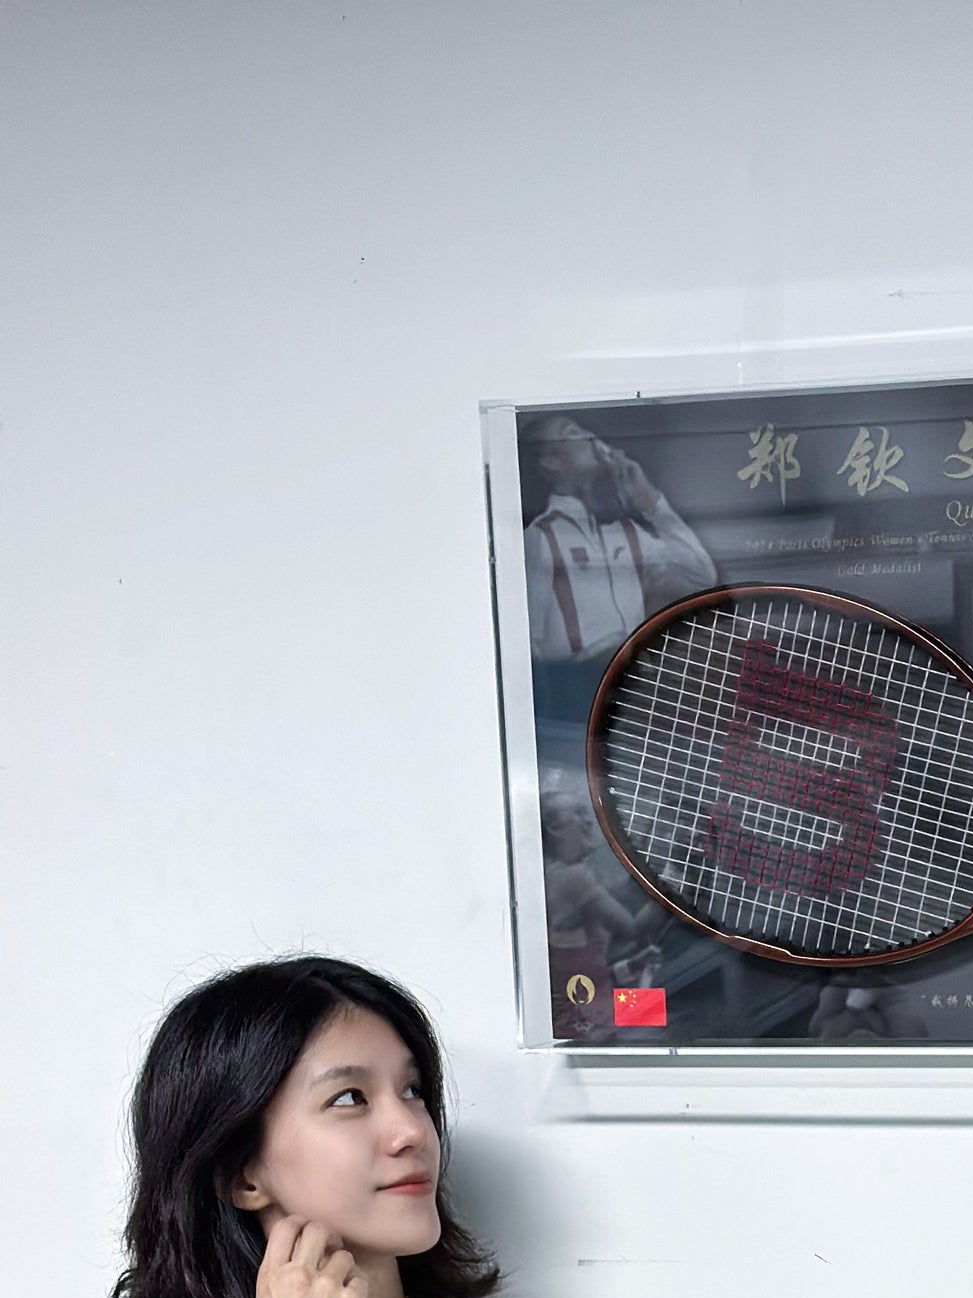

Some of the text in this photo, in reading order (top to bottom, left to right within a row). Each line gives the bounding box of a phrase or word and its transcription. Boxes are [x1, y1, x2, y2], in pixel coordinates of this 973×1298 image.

[811, 535, 865, 551] Olympics
[837, 561, 921, 576] Gold Medalist
